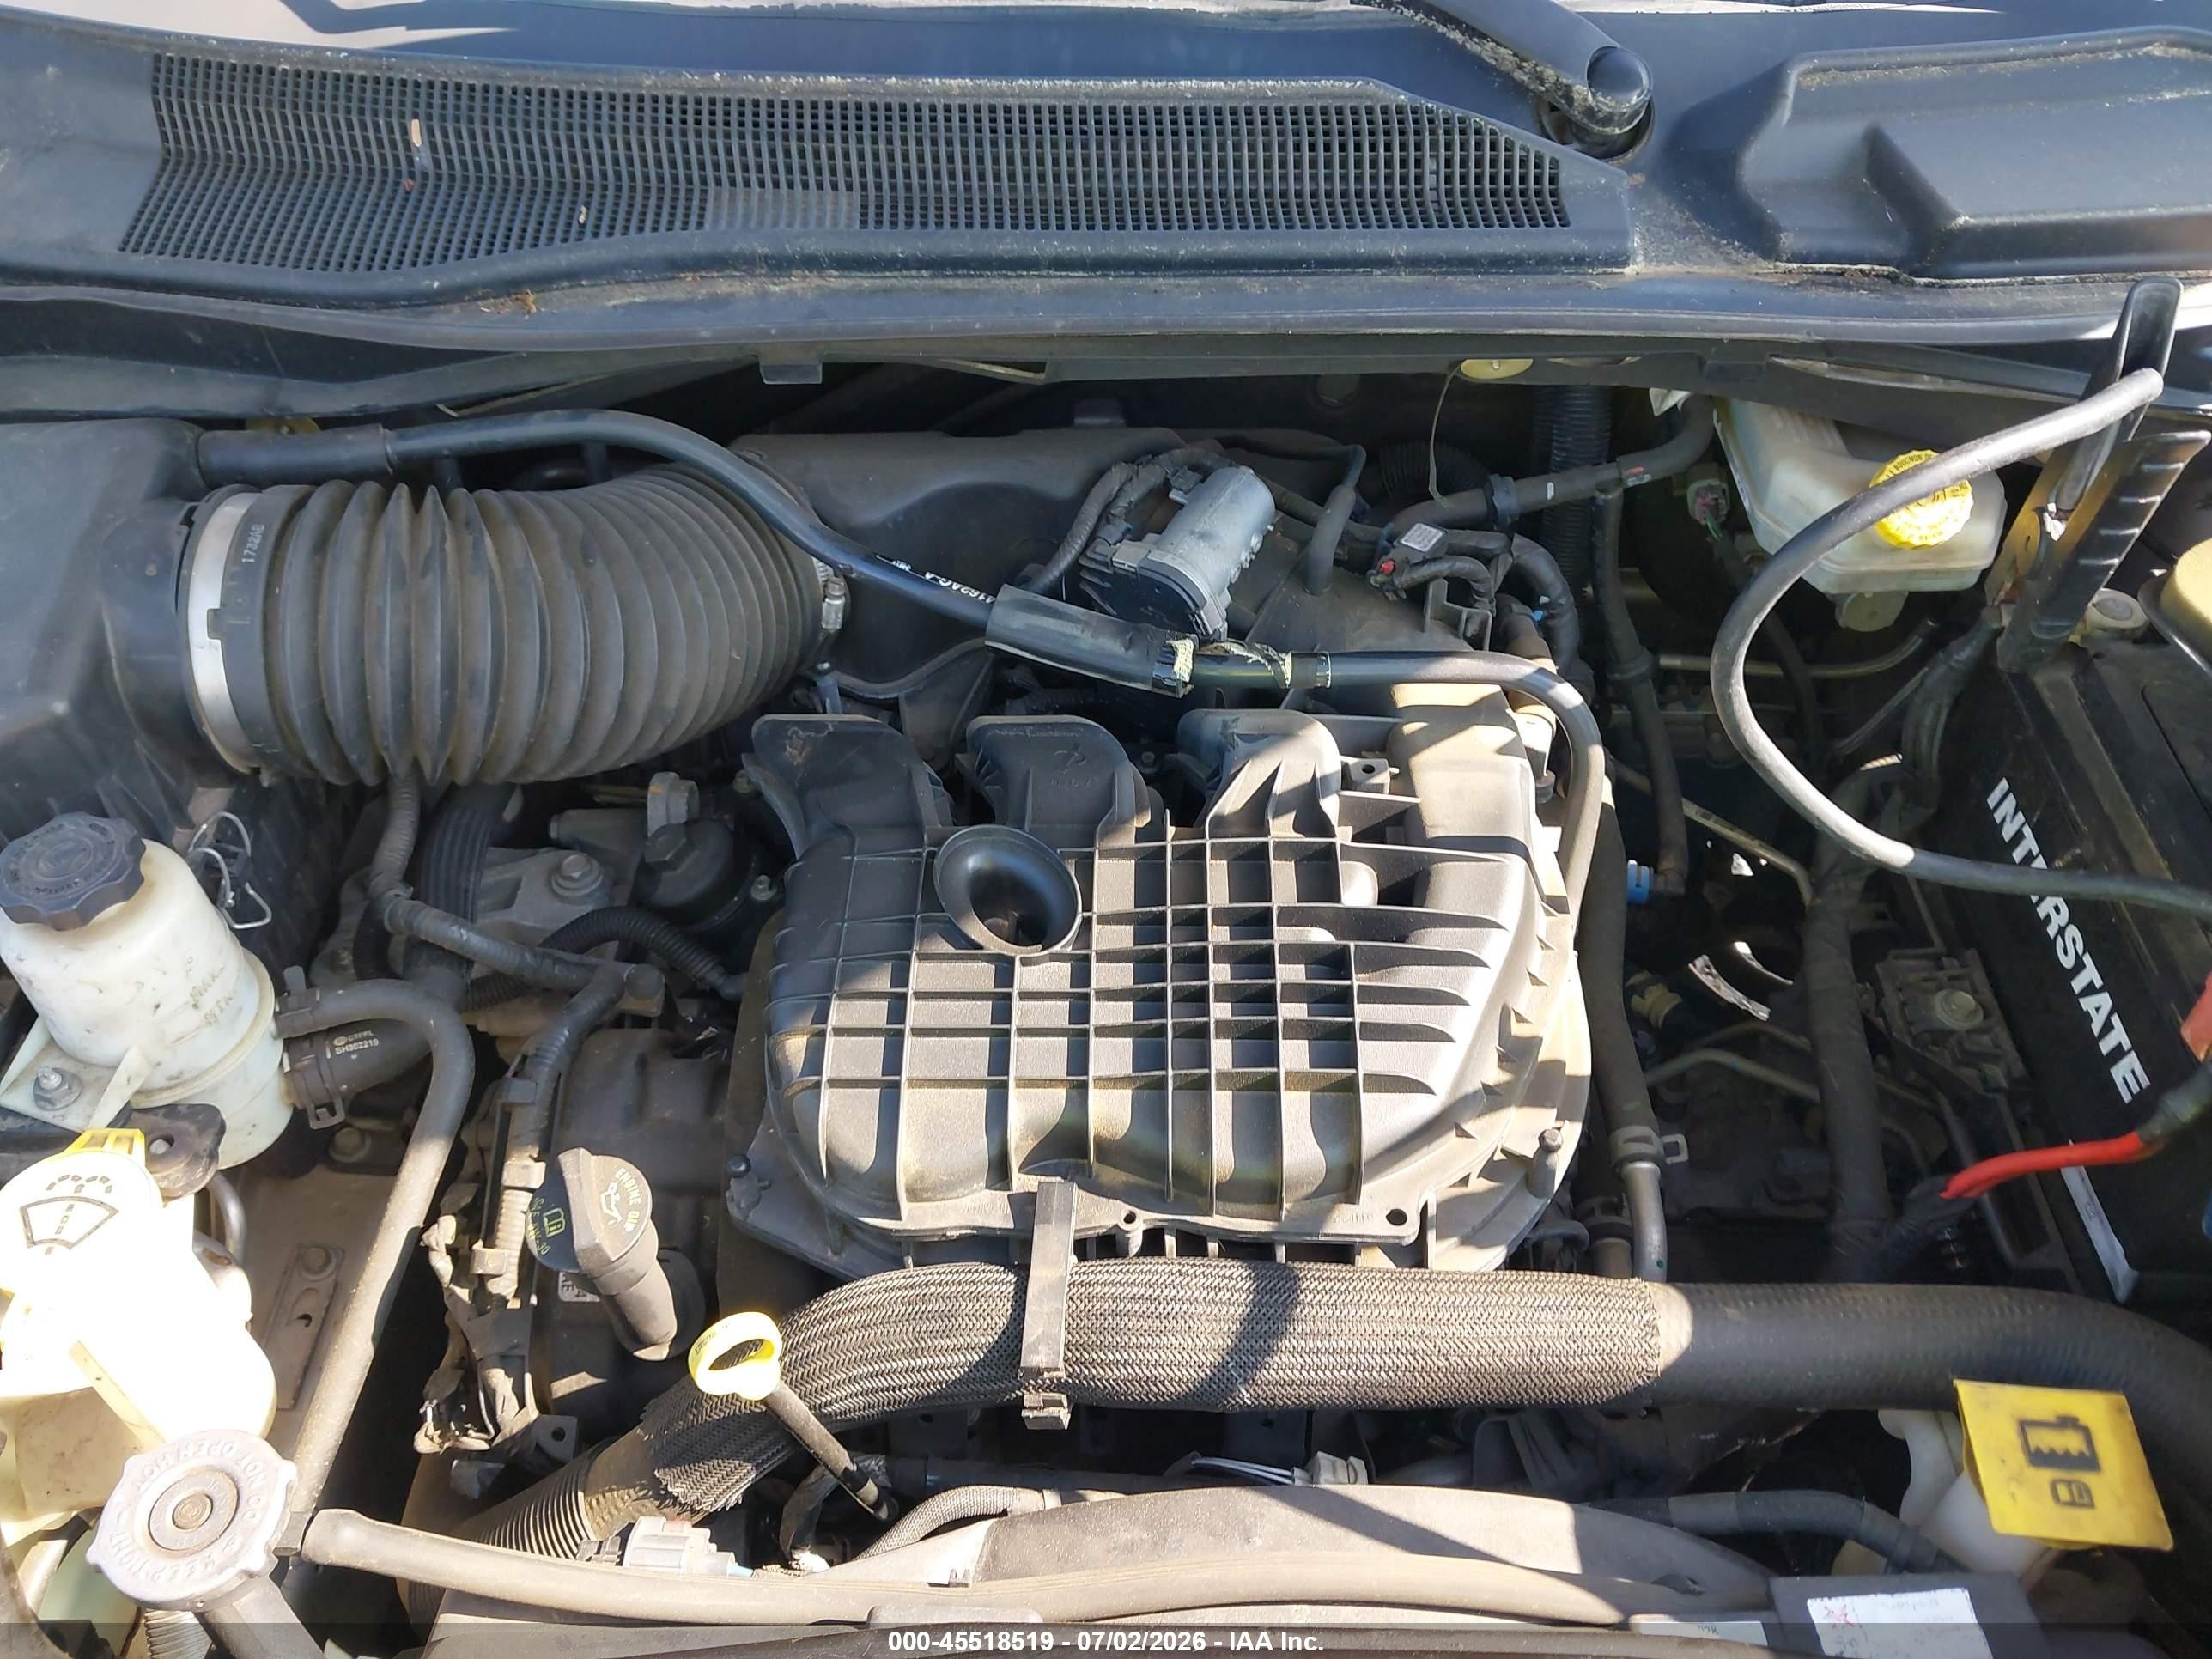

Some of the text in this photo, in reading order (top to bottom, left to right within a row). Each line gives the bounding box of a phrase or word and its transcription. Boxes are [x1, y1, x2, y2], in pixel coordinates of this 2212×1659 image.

[1986, 777, 2150, 1104] INTRSTATE
[614, 1167, 642, 1232] ENGINE OIL
